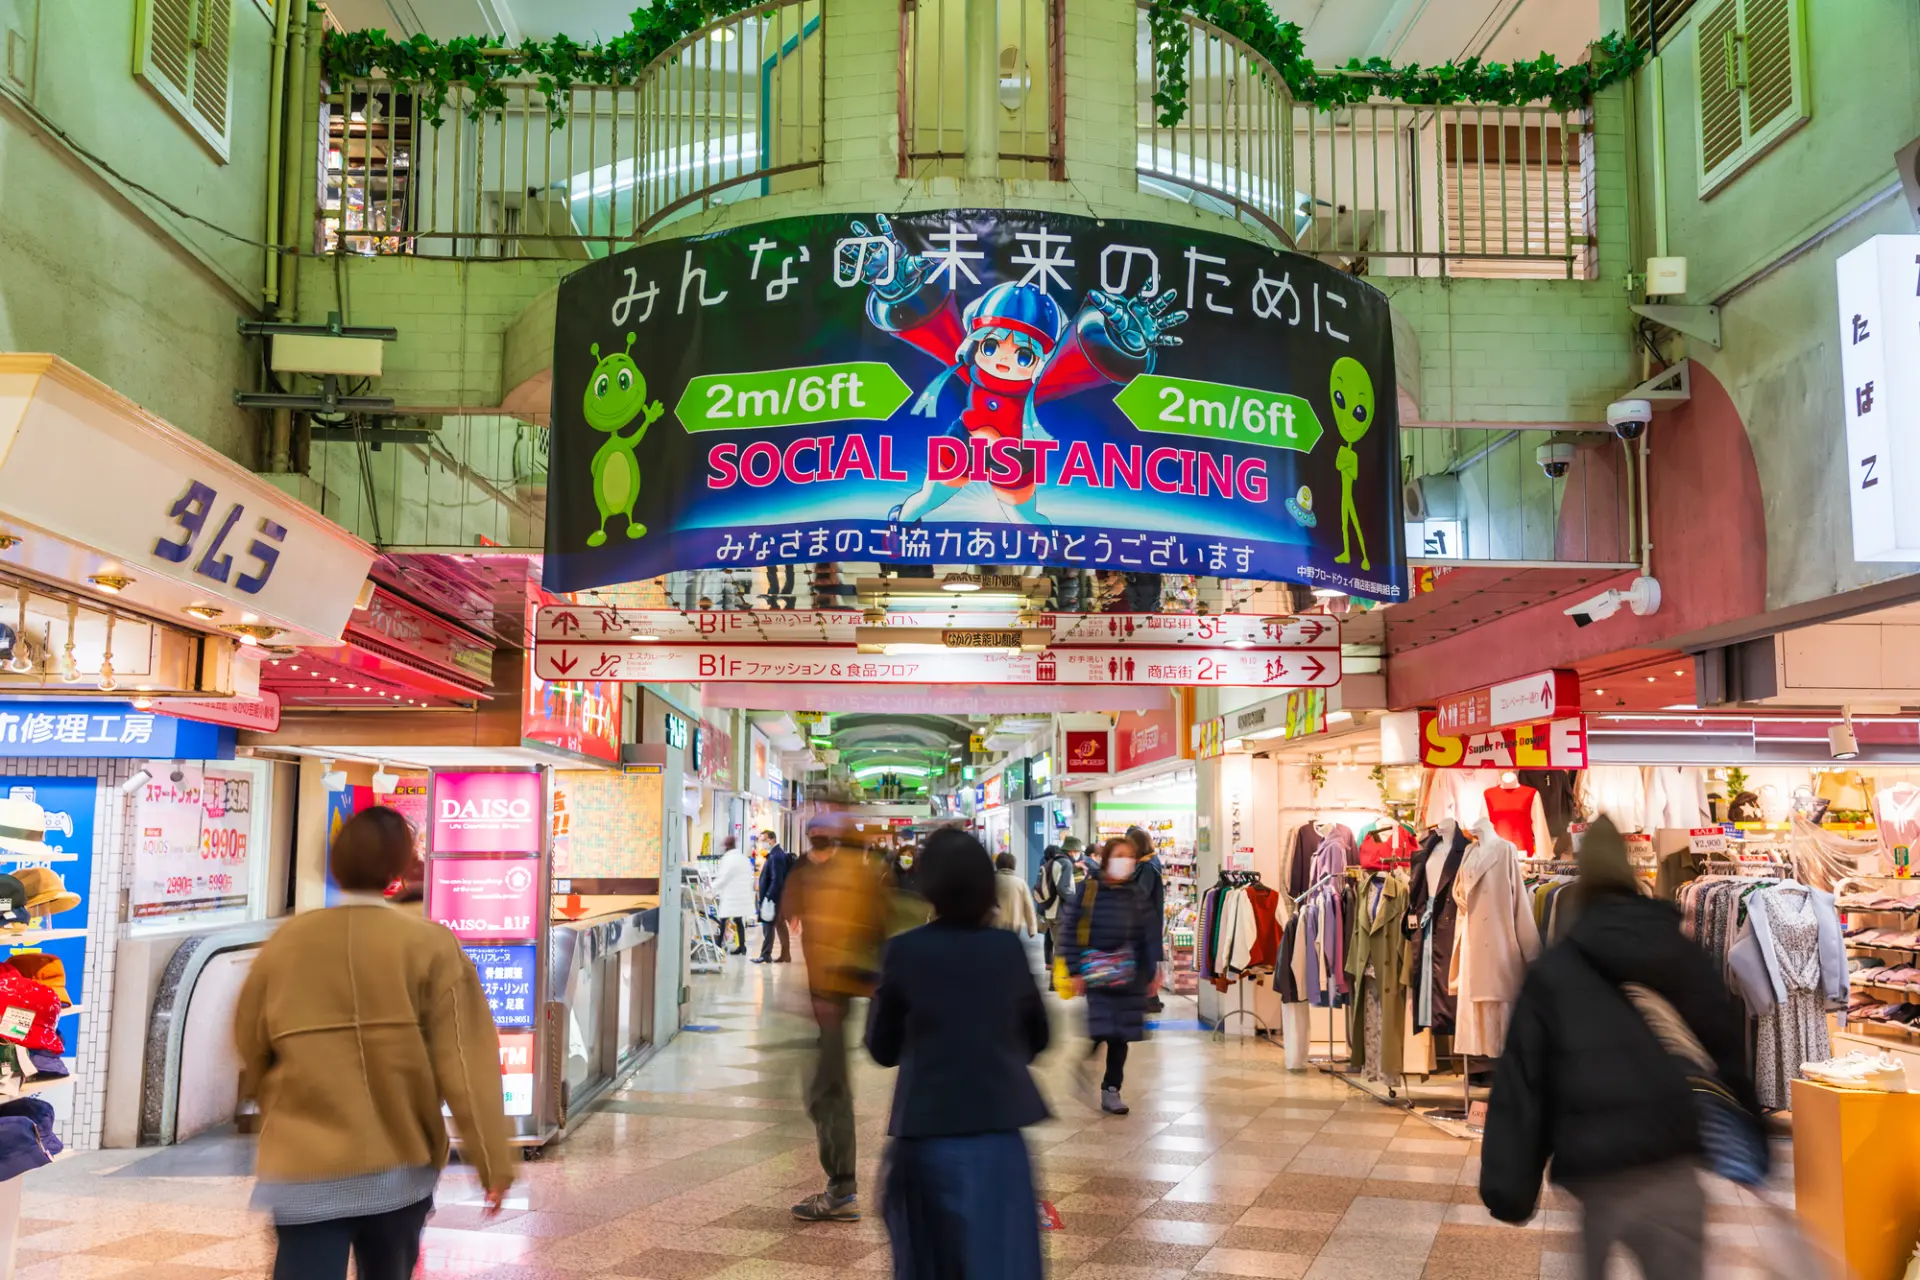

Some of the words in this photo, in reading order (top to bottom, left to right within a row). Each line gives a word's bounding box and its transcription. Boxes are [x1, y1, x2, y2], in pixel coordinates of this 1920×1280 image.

[611, 223, 1350, 342] みんなの未来のために
[705, 372, 866, 419] 2m/6ft
[1852, 314, 1879, 489] たばこ
[1158, 386, 1298, 439] 2m/6ft
[706, 433, 908, 490] SOCIAL
[927, 435, 1269, 503] DISTANCING
[154, 479, 288, 594] タムラ
[716, 524, 1255, 573] みなさまのご協力ありがとうございます
[1297, 565, 1401, 596] 中野ブロードウェイ商店街振興組合
[699, 654, 742, 677] B1F
[747, 662, 827, 676] ファッション
[830, 663, 842, 677] &
[847, 663, 919, 677] 食品フロア
[1068, 655, 1104, 663] お手洗い
[1147, 664, 1193, 680] 商店街
[1197, 657, 1228, 681] 2F
[1425, 717, 1584, 767] SALE
[1468, 743, 1494, 755] Super
[441, 798, 531, 819] DAISO
[1576, 823, 1590, 832] SA
[201, 828, 247, 859] 3990円
[1694, 838, 1721, 849] ¥2,900
[440, 919, 488, 931] DAISO
[466, 953, 511, 962] ディリフレーヌ
[488, 998, 524, 1011] 体・足裏
[499, 1047, 527, 1066] TM
